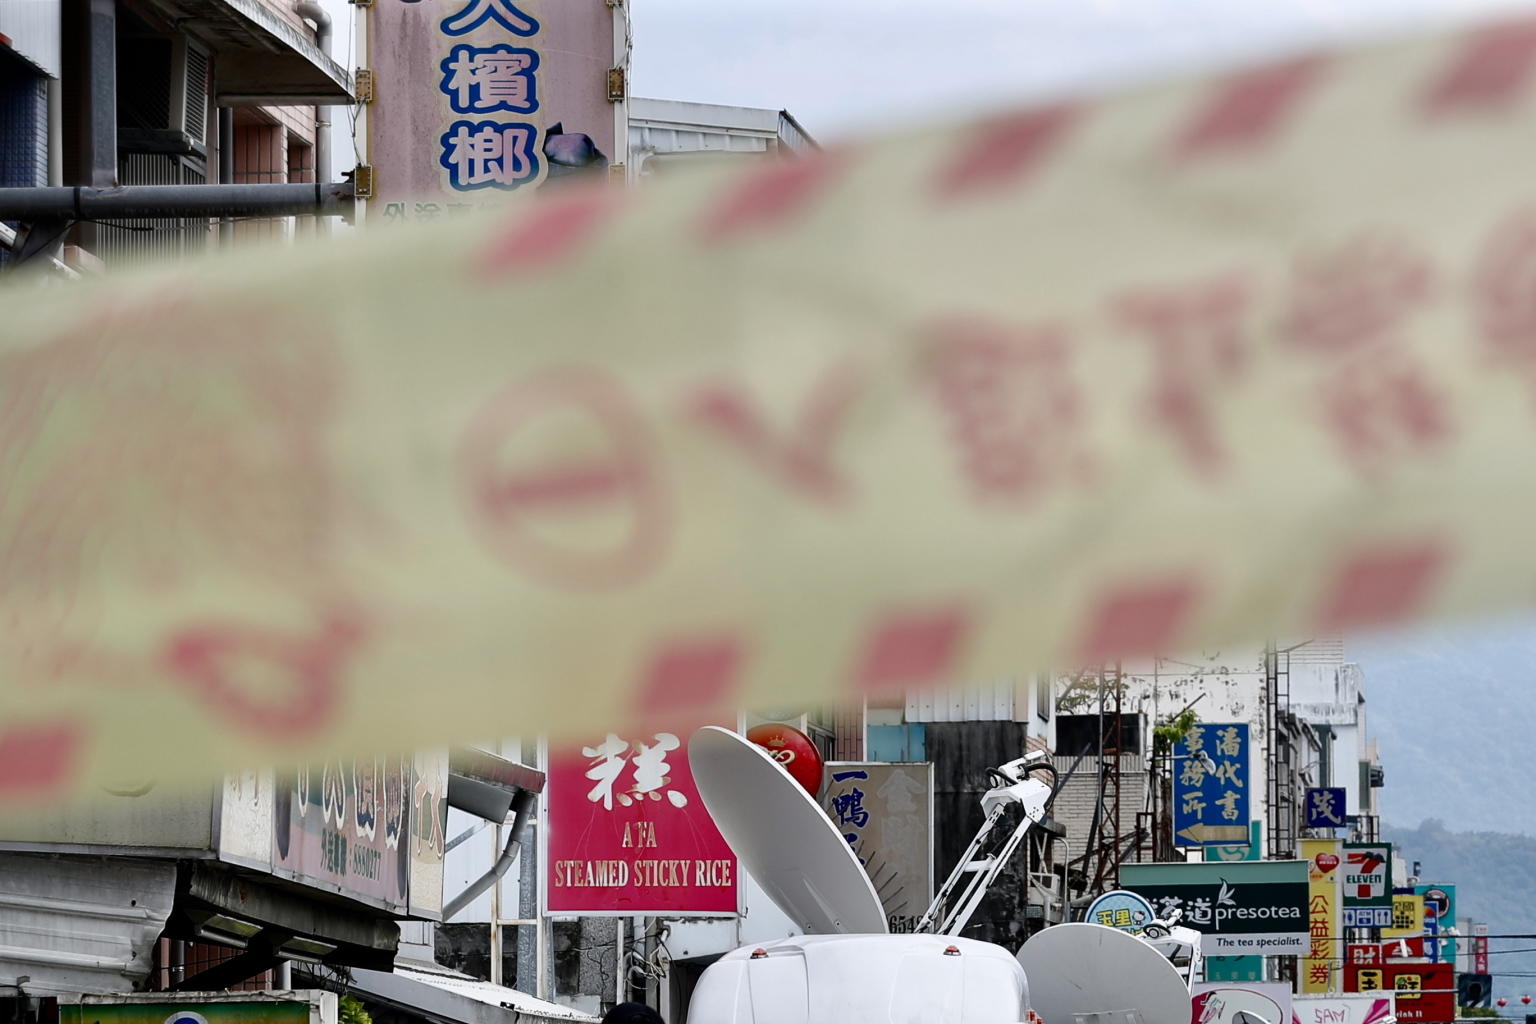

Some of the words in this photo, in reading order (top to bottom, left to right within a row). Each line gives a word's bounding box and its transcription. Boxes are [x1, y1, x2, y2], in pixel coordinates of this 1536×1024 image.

[622, 821, 633, 848] A
[555, 860, 629, 887] STEAMED
[633, 860, 690, 887] STICKY
[695, 860, 732, 887] RICE
[1145, 896, 1212, 925] 茶道
[1215, 905, 1301, 931] presotea
[1216, 937, 1234, 947] The
[1237, 937, 1253, 947] tea
[1256, 935, 1303, 950] specialist.
[1309, 895, 1329, 985] 公益彩券
